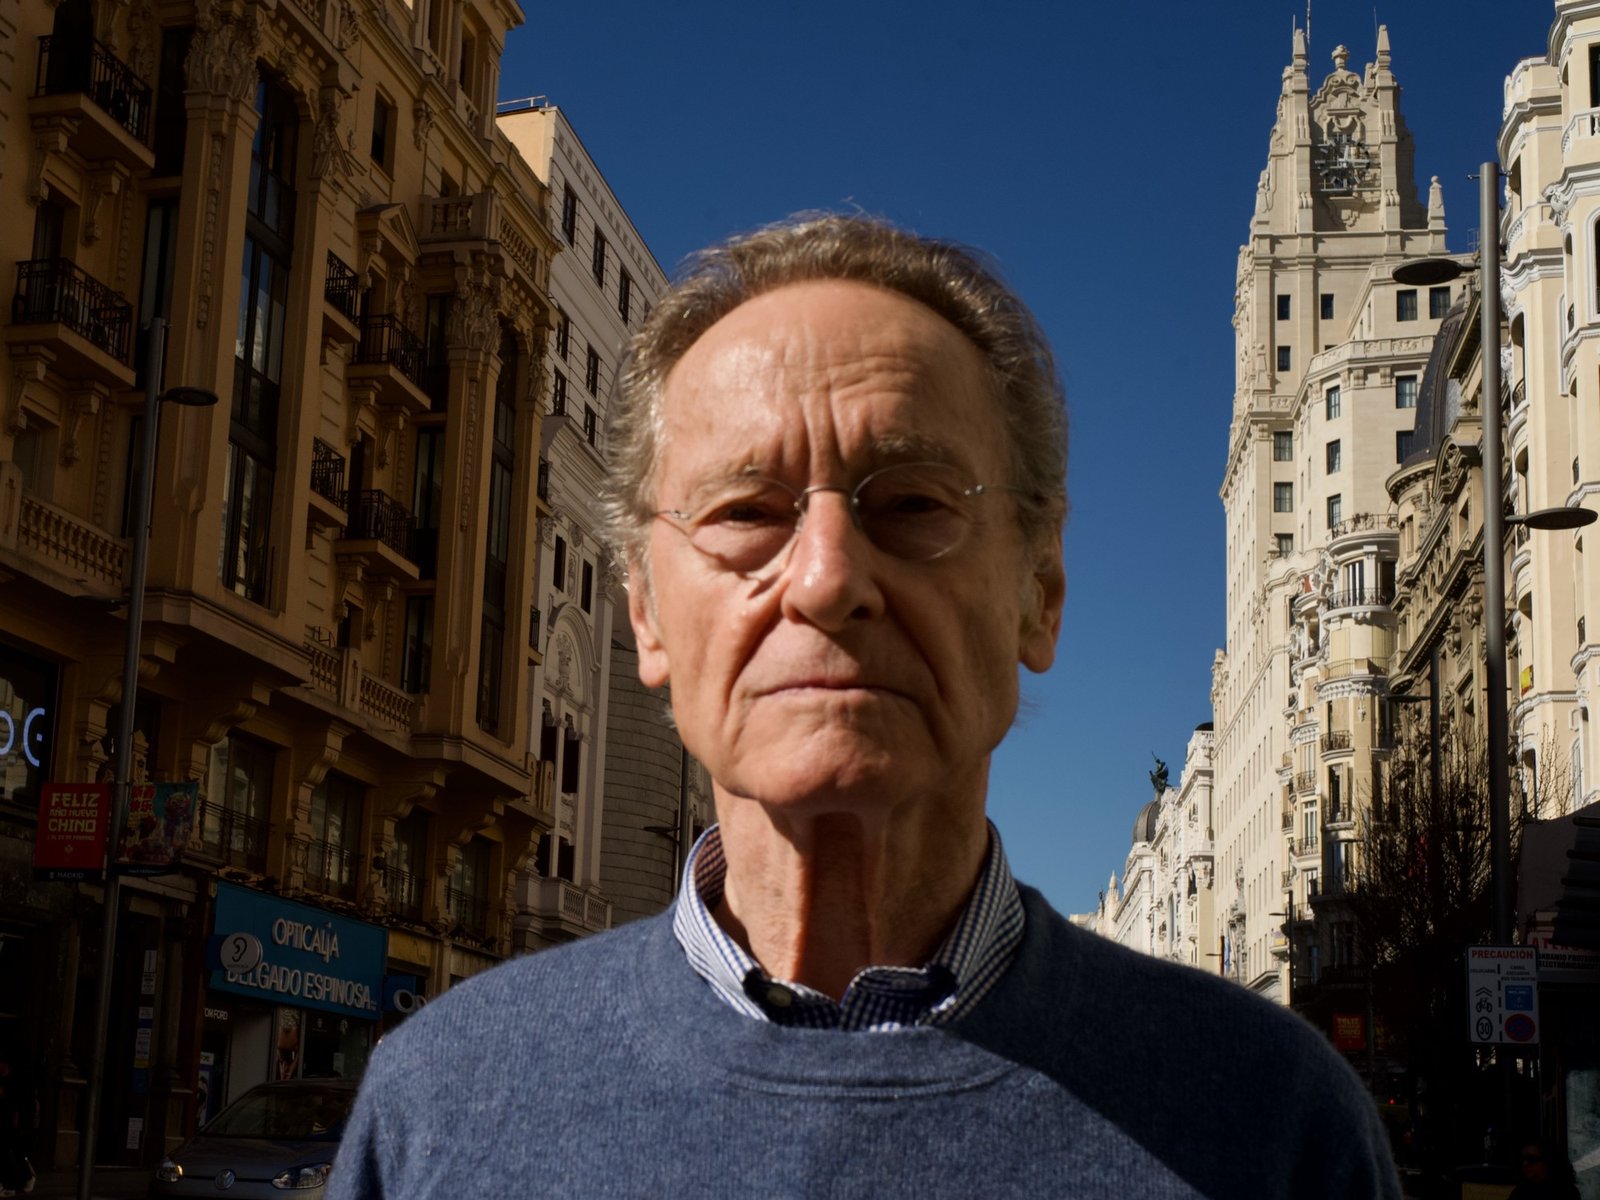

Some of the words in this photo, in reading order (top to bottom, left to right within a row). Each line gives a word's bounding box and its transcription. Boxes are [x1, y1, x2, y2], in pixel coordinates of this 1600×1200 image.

[51, 792, 101, 808] FELIZ
[49, 807, 67, 817] AÑO
[68, 809, 98, 818] NUEVO
[48, 818, 97, 833] CHINO
[57, 871, 85, 879] MADRID
[1472, 949, 1533, 959] PRECAUCIÓN
[303, 972, 372, 1010] ESPINOSA
[1479, 1022, 1490, 1035] 30
